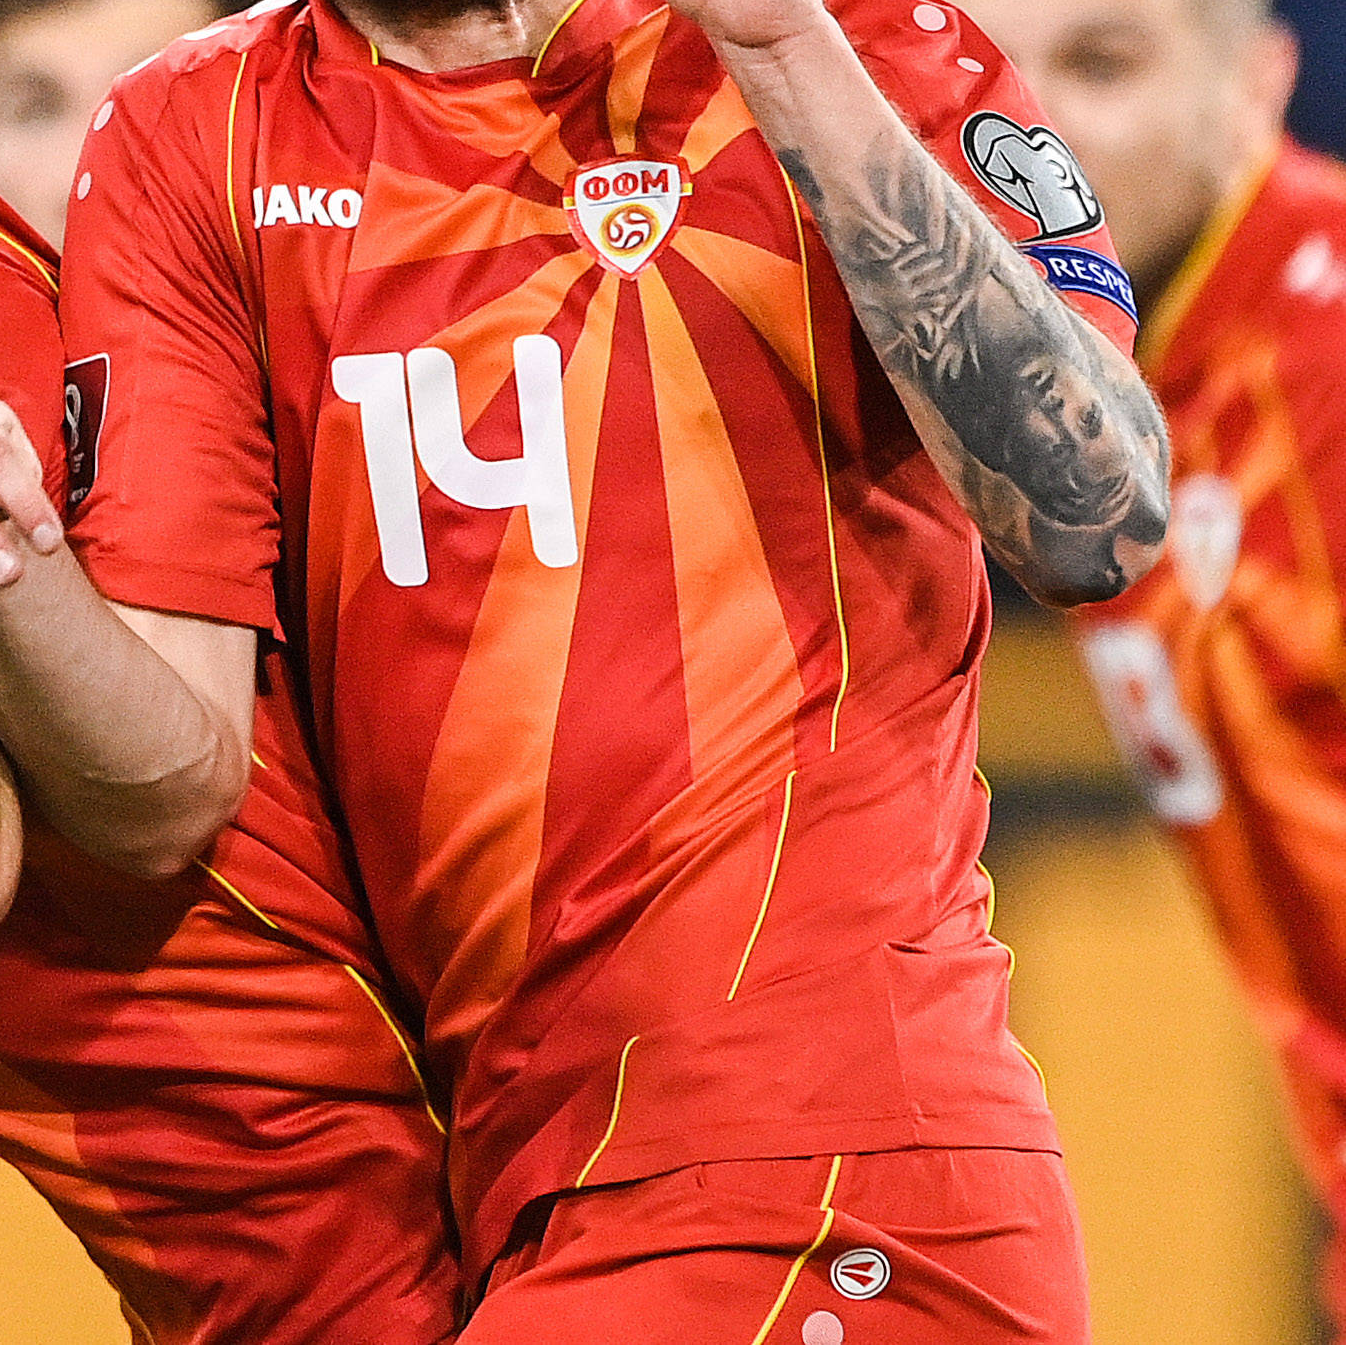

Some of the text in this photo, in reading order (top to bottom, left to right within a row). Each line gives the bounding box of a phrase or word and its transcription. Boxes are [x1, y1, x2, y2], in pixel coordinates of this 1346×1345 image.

[253, 185, 363, 229] JAKO
[1048, 257, 1134, 306] RESPE
[331, 334, 579, 587] 14
